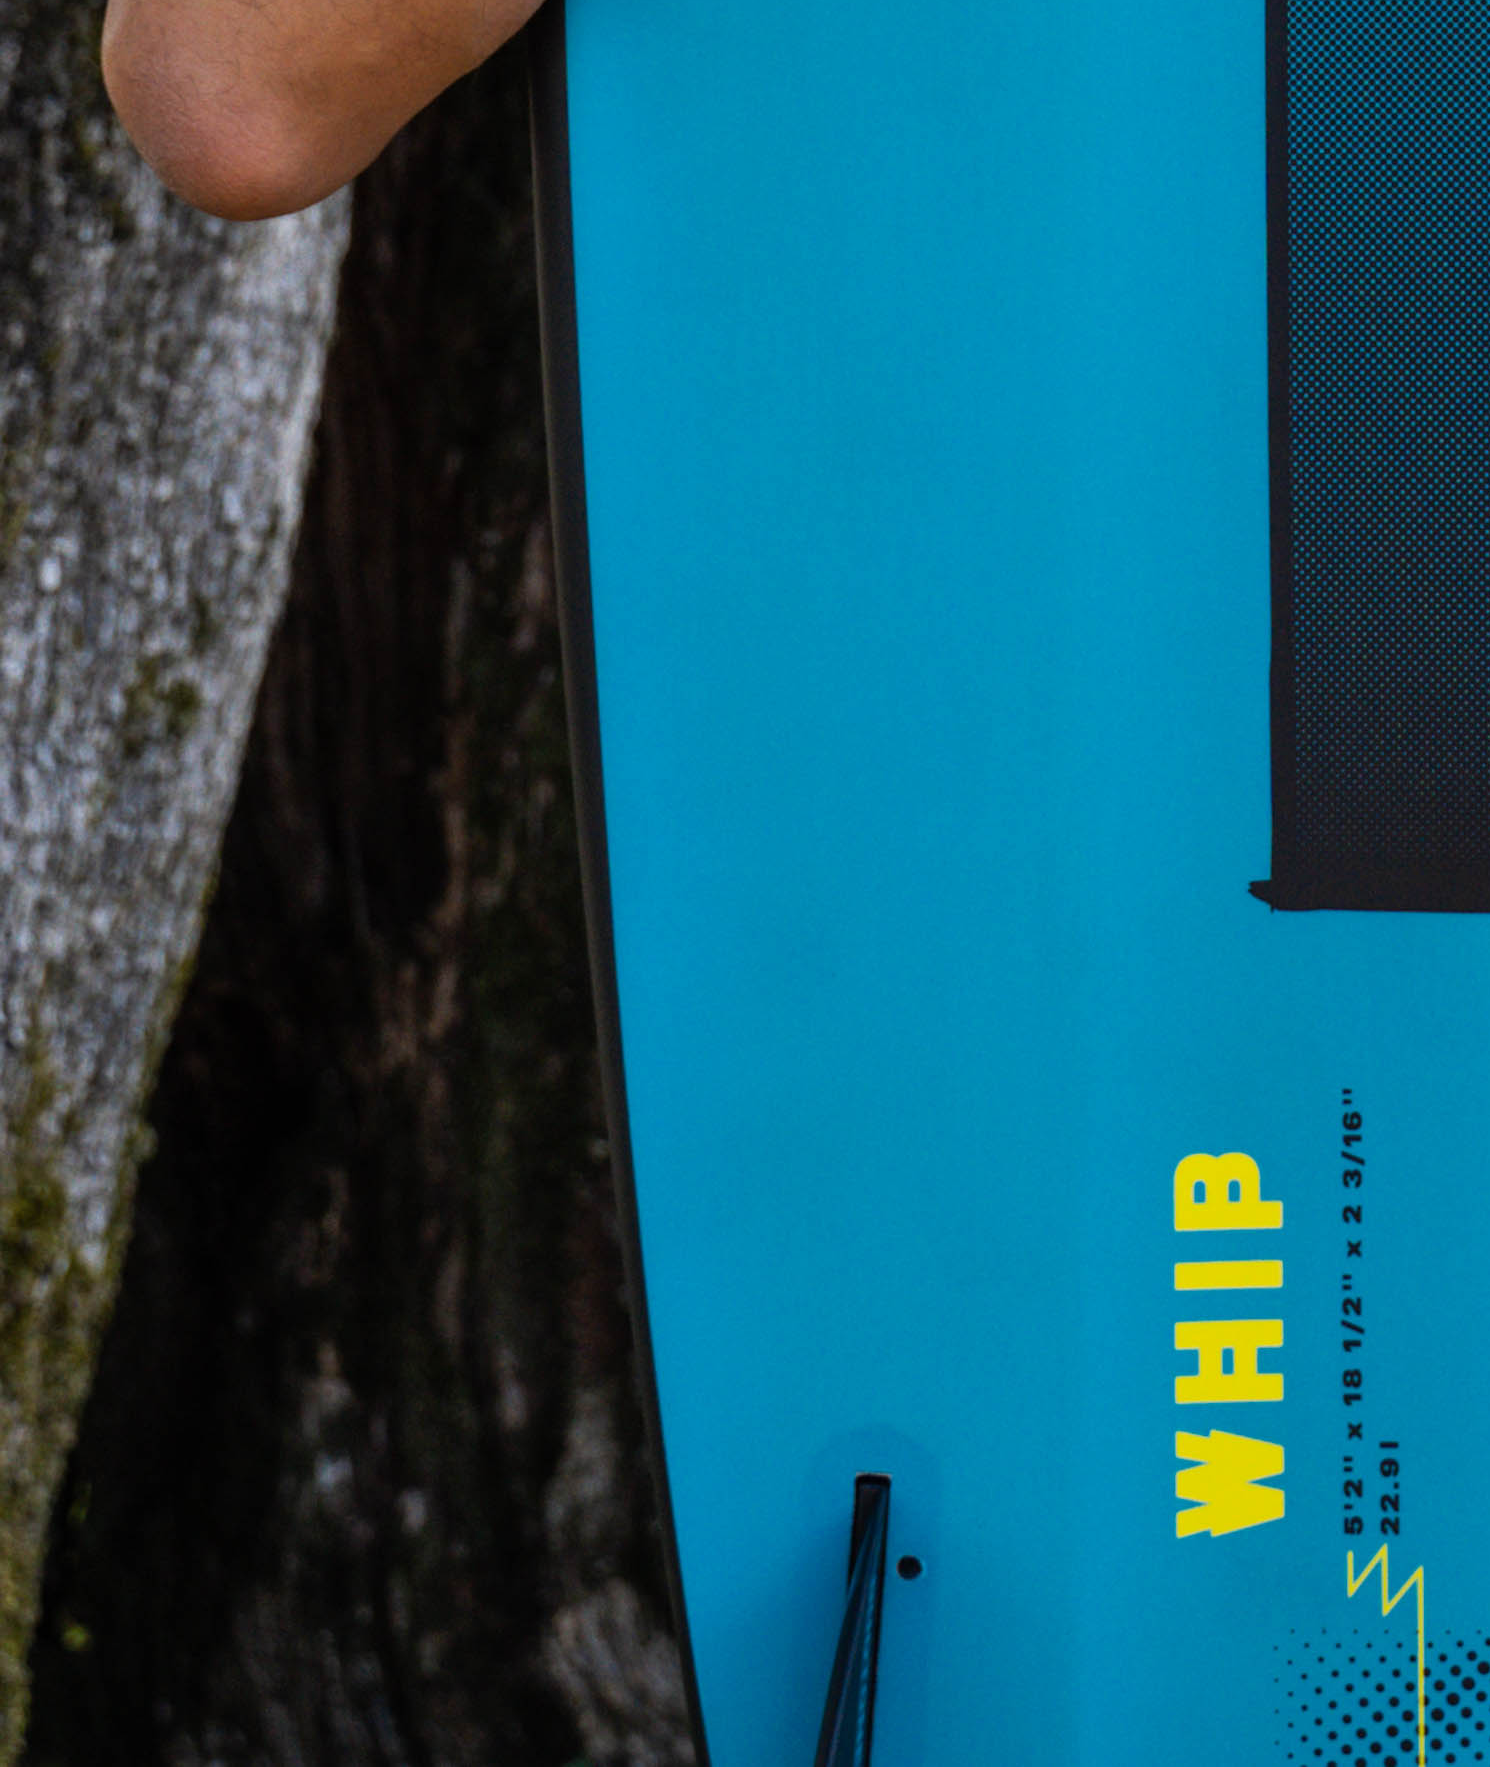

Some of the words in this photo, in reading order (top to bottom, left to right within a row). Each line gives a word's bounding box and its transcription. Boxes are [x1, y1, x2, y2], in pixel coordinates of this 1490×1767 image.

[1341, 1205, 1363, 1224] 2
[1174, 1152, 1285, 1539] WHIP
[1341, 1368, 1363, 1406] 18
